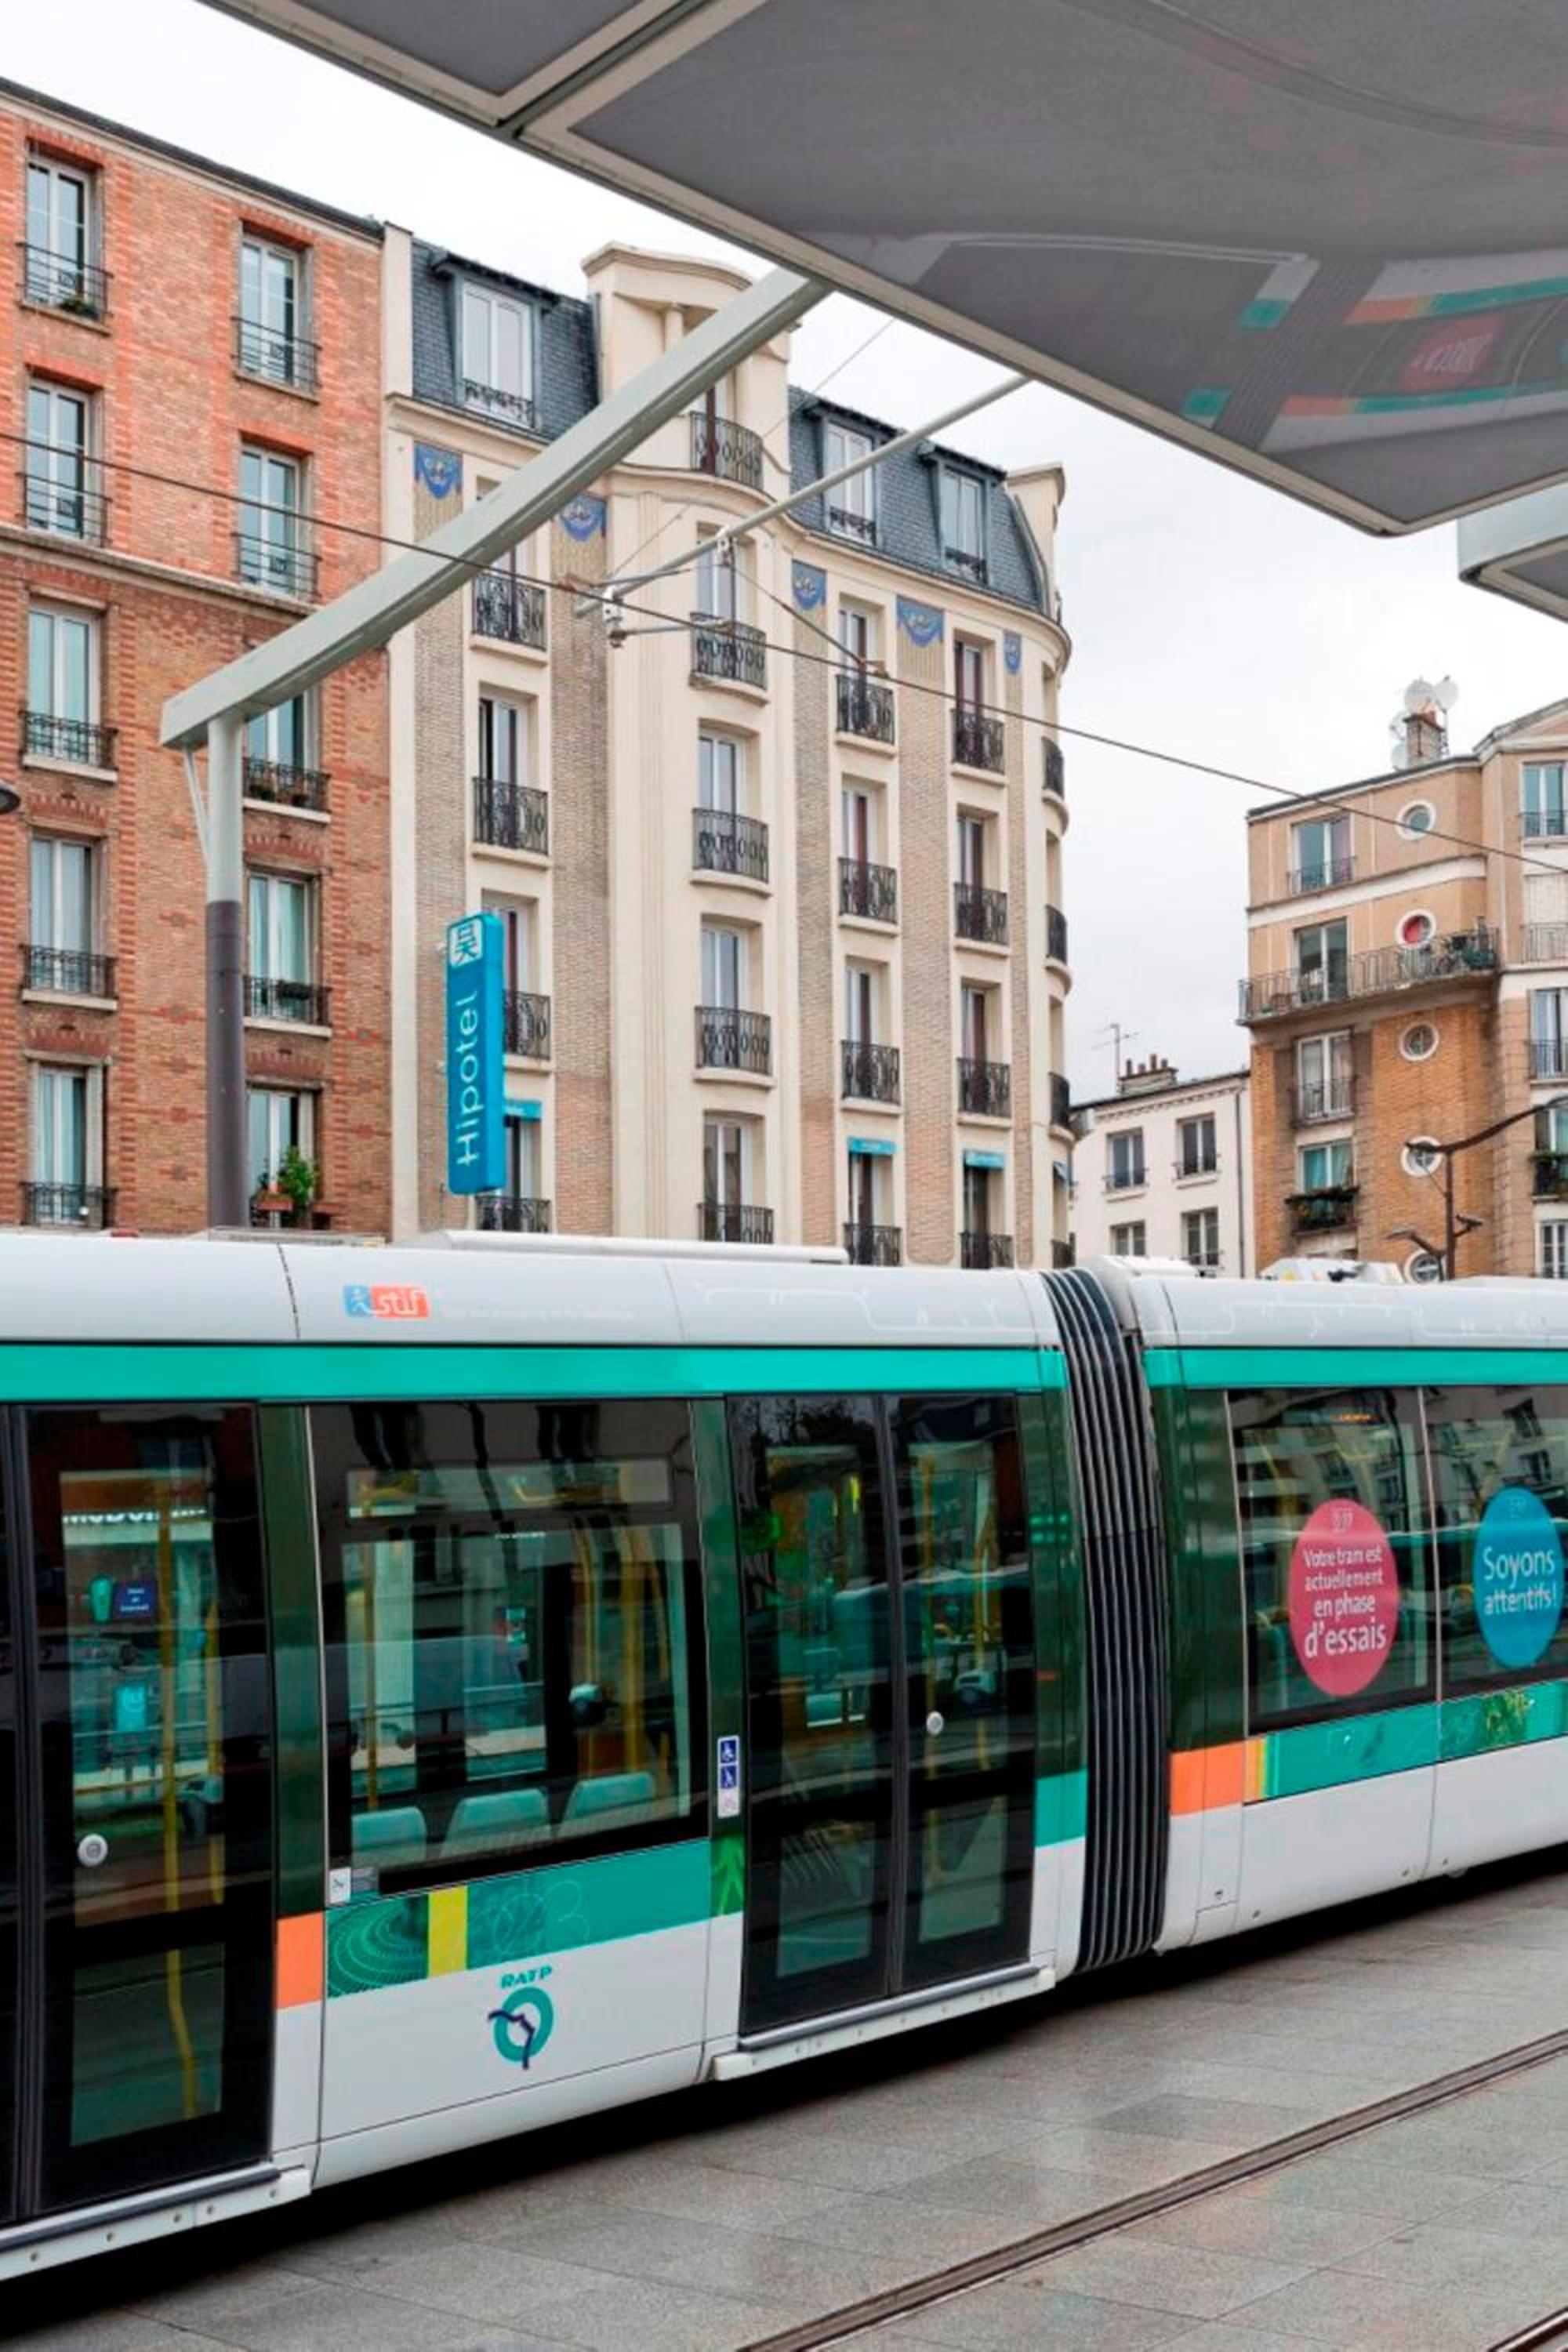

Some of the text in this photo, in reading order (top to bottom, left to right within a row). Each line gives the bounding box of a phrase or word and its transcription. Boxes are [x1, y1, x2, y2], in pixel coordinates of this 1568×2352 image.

[456, 989, 485, 1167] Hipotel
[375, 1286, 426, 1315] stif
[1302, 1548, 1336, 1568] Votre
[1365, 1544, 1382, 1563] est
[1483, 1545, 1555, 1590] Soyons
[1304, 1567, 1384, 1592] actuellement
[1314, 1589, 1376, 1622] en phase
[501, 1964, 553, 1988] RATP
